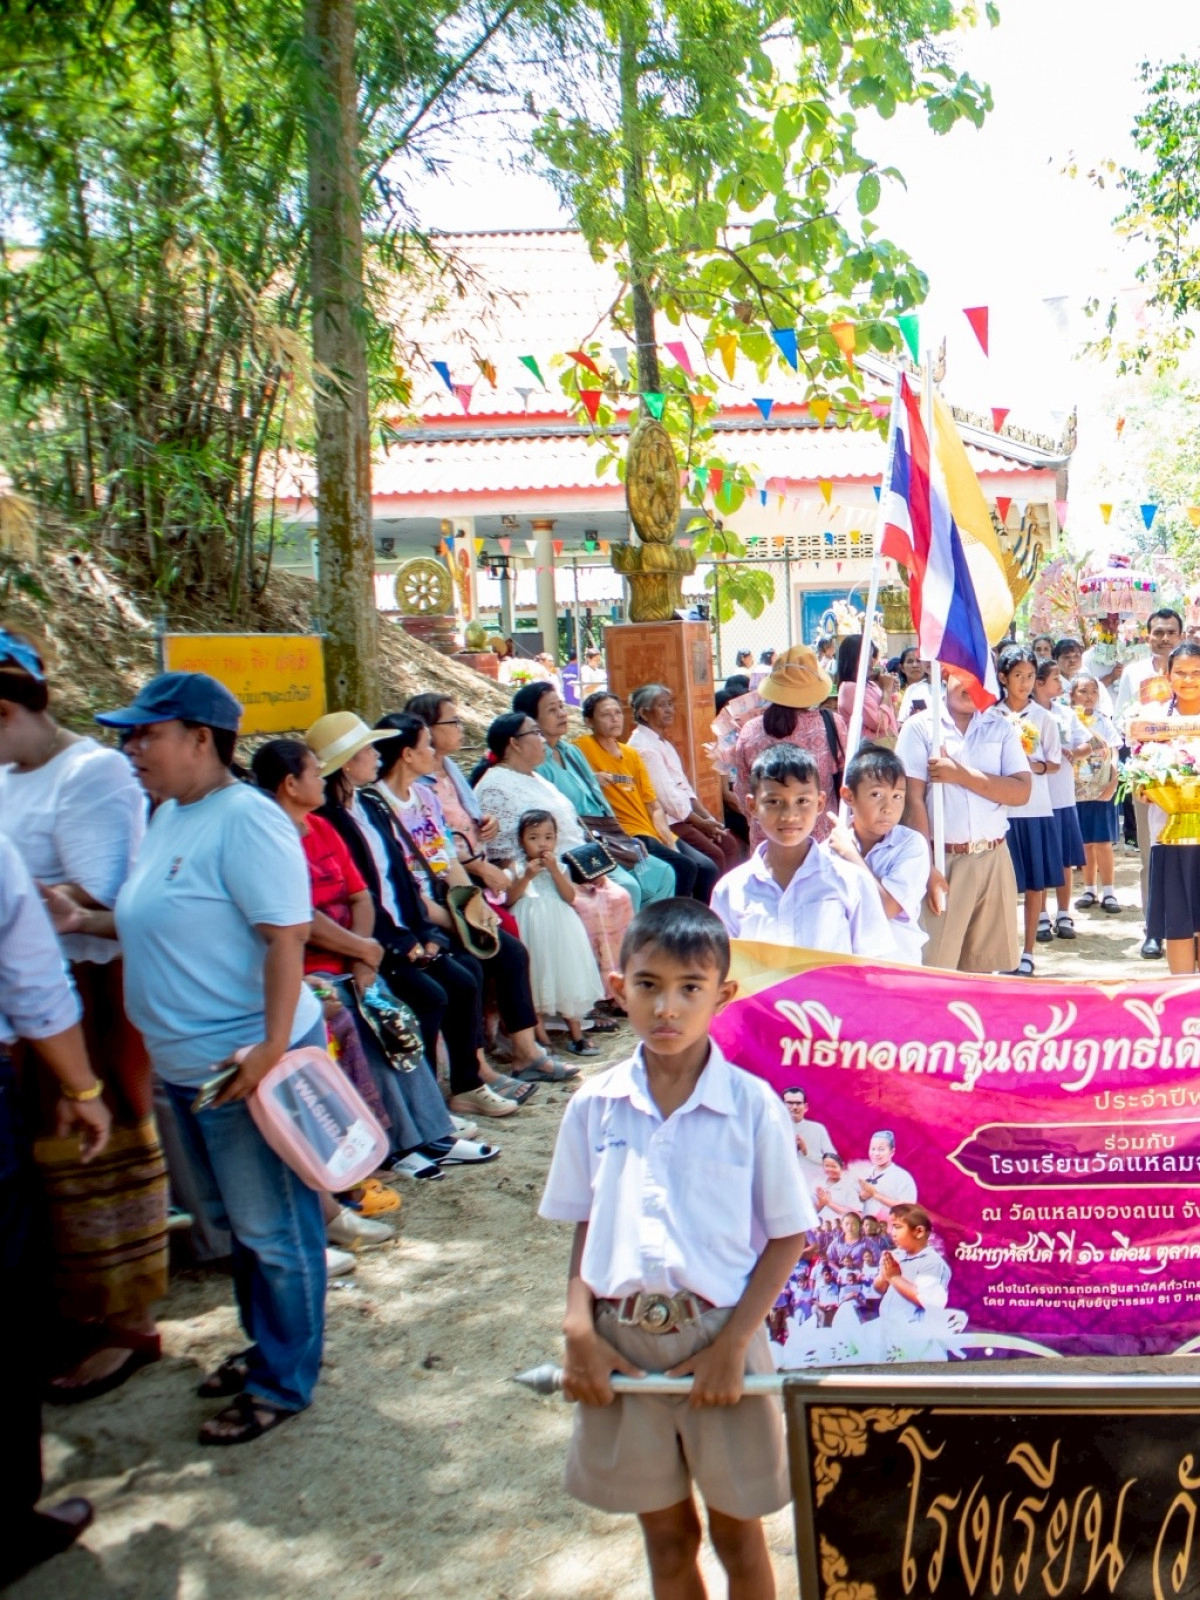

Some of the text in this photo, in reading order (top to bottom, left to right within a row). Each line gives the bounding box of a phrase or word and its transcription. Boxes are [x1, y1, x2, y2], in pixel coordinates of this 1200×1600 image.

[1104, 1132, 1176, 1151] ร่วมกับ
[981, 1206, 1002, 1221] ณ
[1009, 1203, 1175, 1221] วัดแหลมจองถนน
[1110, 1231, 1150, 1263] เดือน
[983, 1296, 1005, 1307] โดย
[1157, 1296, 1170, 1305] 81
[1174, 1292, 1182, 1303] ปี
[897, 1425, 1138, 1597] โรงเรียน
